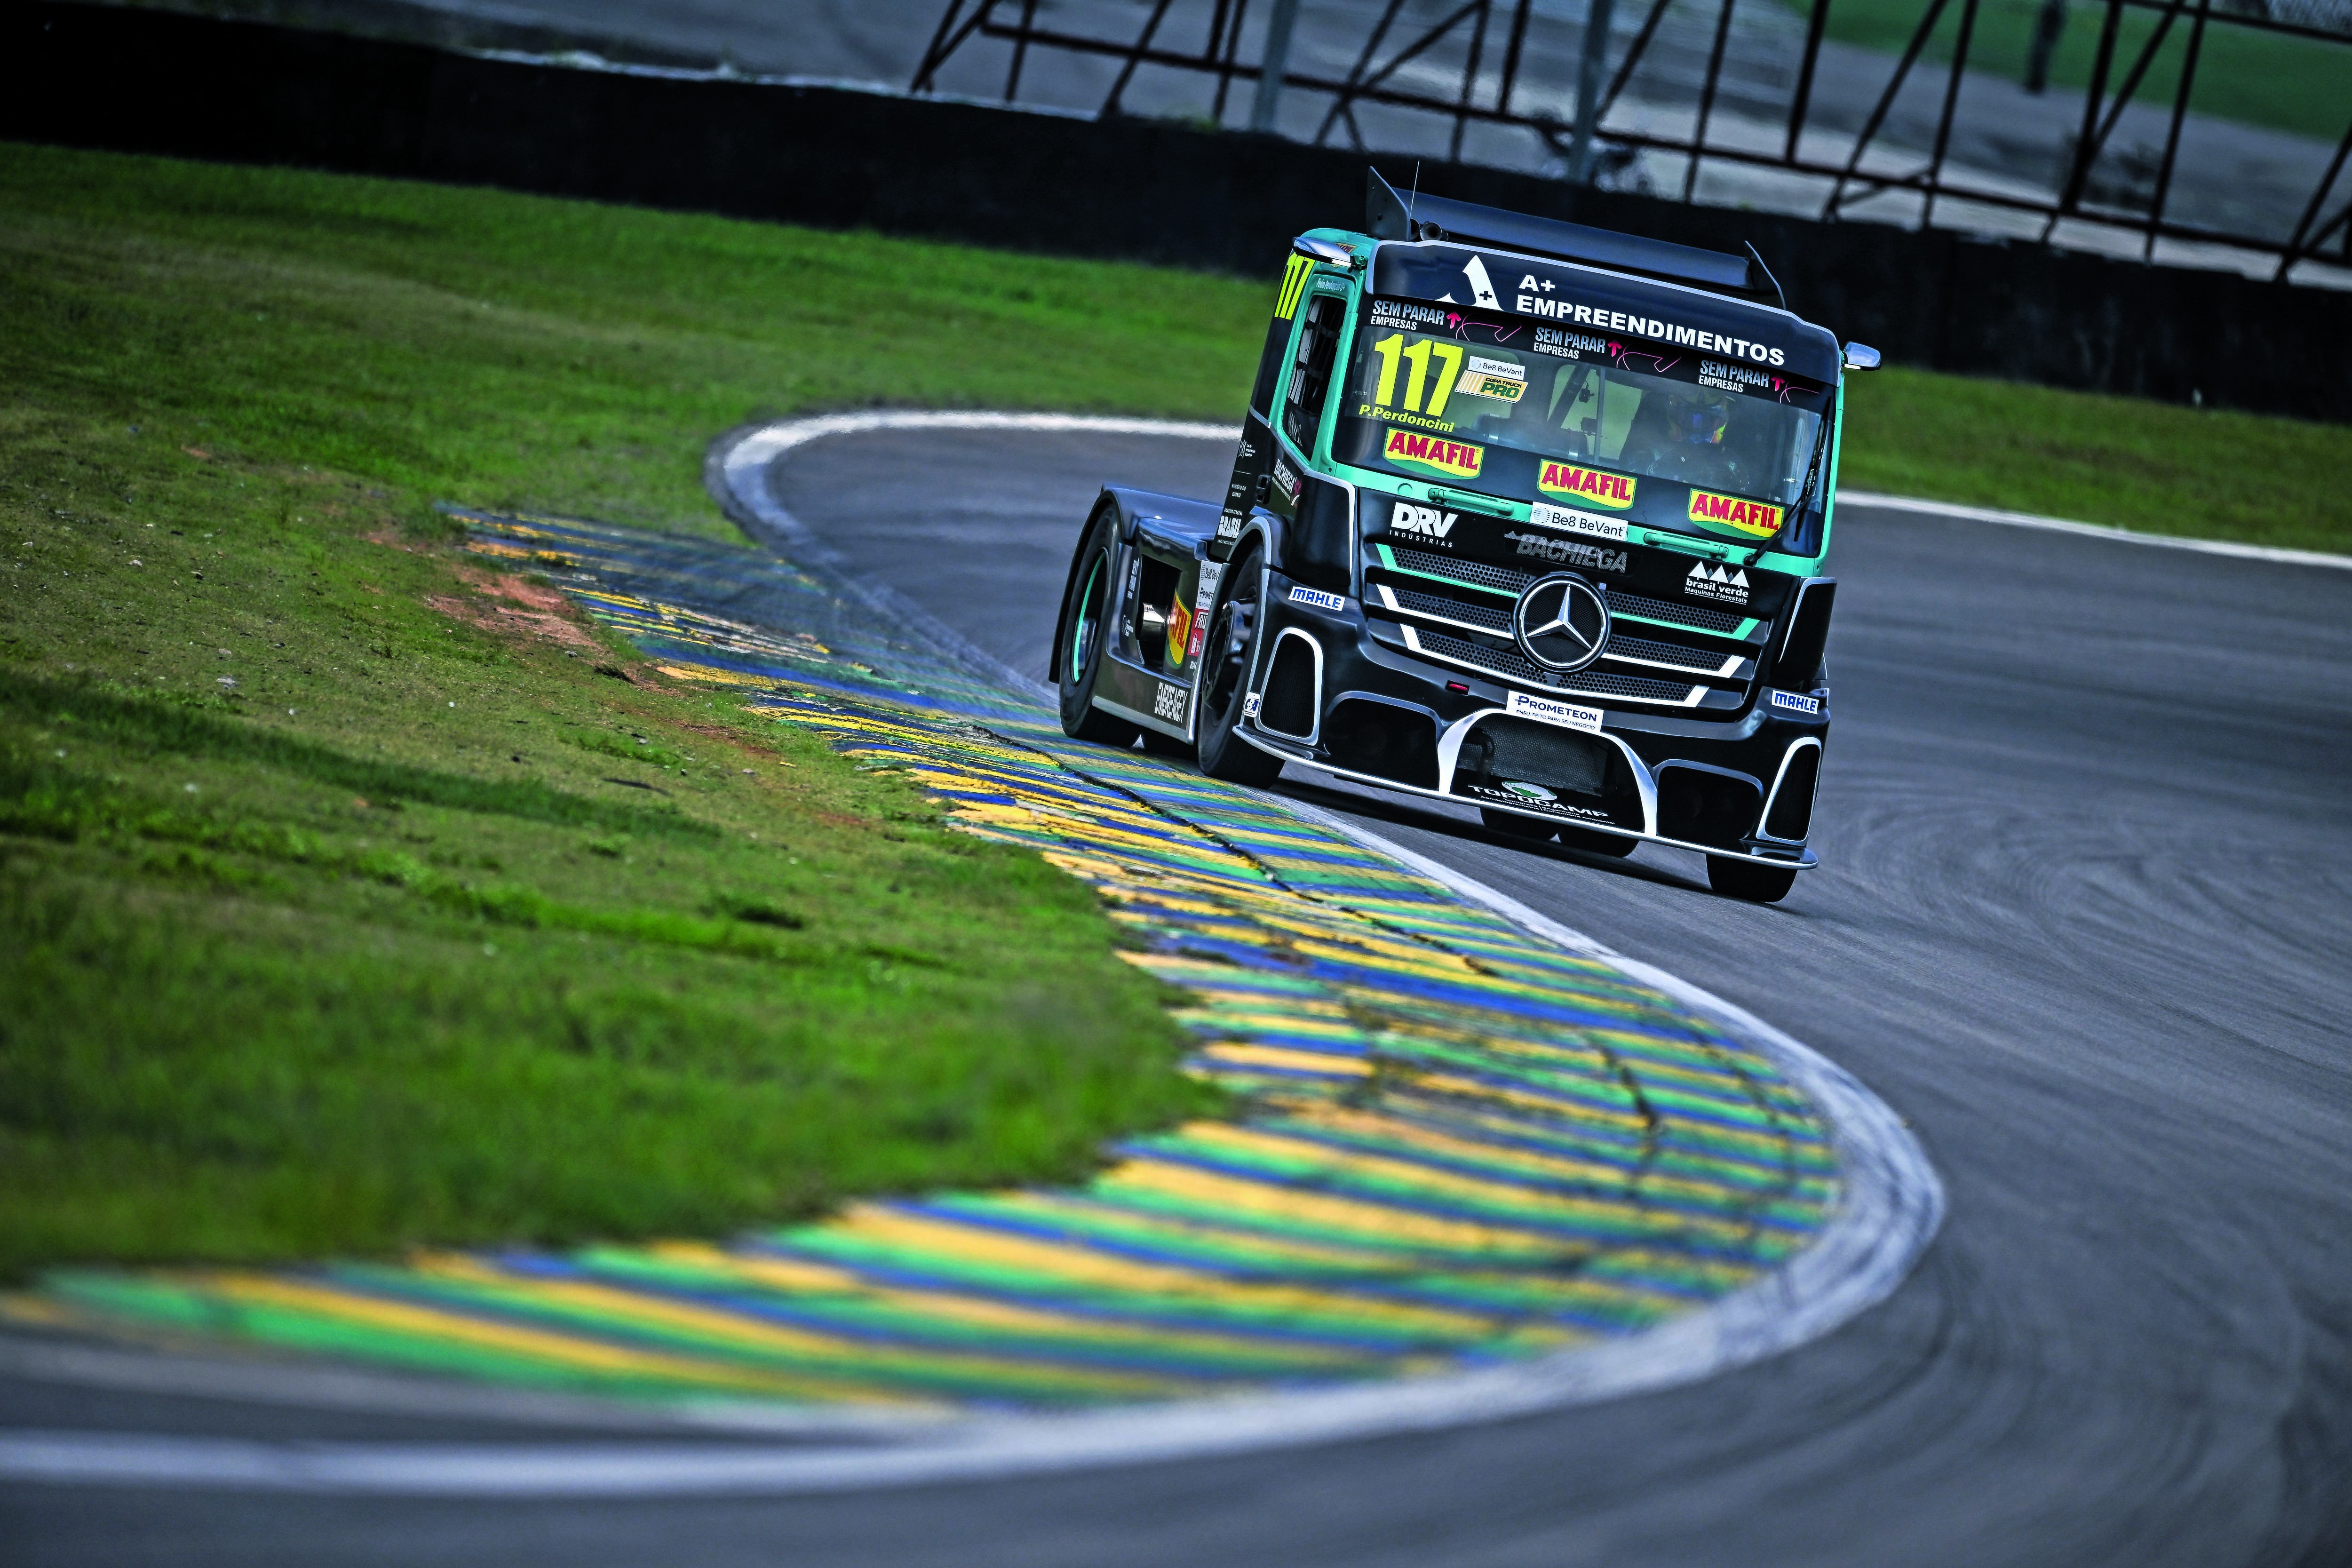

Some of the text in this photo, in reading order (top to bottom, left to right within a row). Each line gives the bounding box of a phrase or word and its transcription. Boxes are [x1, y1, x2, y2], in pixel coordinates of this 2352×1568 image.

[1274, 252, 1316, 320] 117
[1518, 274, 1555, 292] A+
[1370, 316, 1417, 331] EMPRESAS
[1373, 300, 1445, 325] SEM PARAR
[1517, 294, 1785, 366] EMPREENDIMENTOS
[1535, 326, 1606, 353] SEM PARAR
[1533, 342, 1580, 359] EMPRESAS
[1374, 334, 1463, 417] 117
[1498, 366, 1522, 376] BeVant
[1699, 375, 1743, 393] EMPRESAS
[1700, 359, 1769, 388] SEM PARAR
[1480, 382, 1520, 398] PRO
[1359, 404, 1455, 433] P.Perdoncini
[1387, 432, 1478, 470] AMAFIL
[1274, 458, 1295, 493] BACHIEGA
[1541, 464, 1631, 501] AMAFIL
[1391, 501, 1459, 538] DRV
[1552, 512, 1623, 537] Be8 BeVant
[1691, 494, 1779, 530] AMAFIL
[1389, 530, 1453, 548] INDÚSTRIAS
[1517, 533, 1628, 573] BACHIEGA
[1291, 588, 1343, 611] MAHLE
[1685, 586, 1747, 603] Maquinas Florestais
[1686, 578, 1748, 598] brasil verde
[1154, 682, 1188, 723] EMBREAGEX
[1515, 695, 1597, 722] PROMETEON
[1774, 692, 1818, 713] MAHLE
[1572, 721, 1595, 730] NEGÓCIO
[1468, 785, 1608, 817] TOPOCAMP
